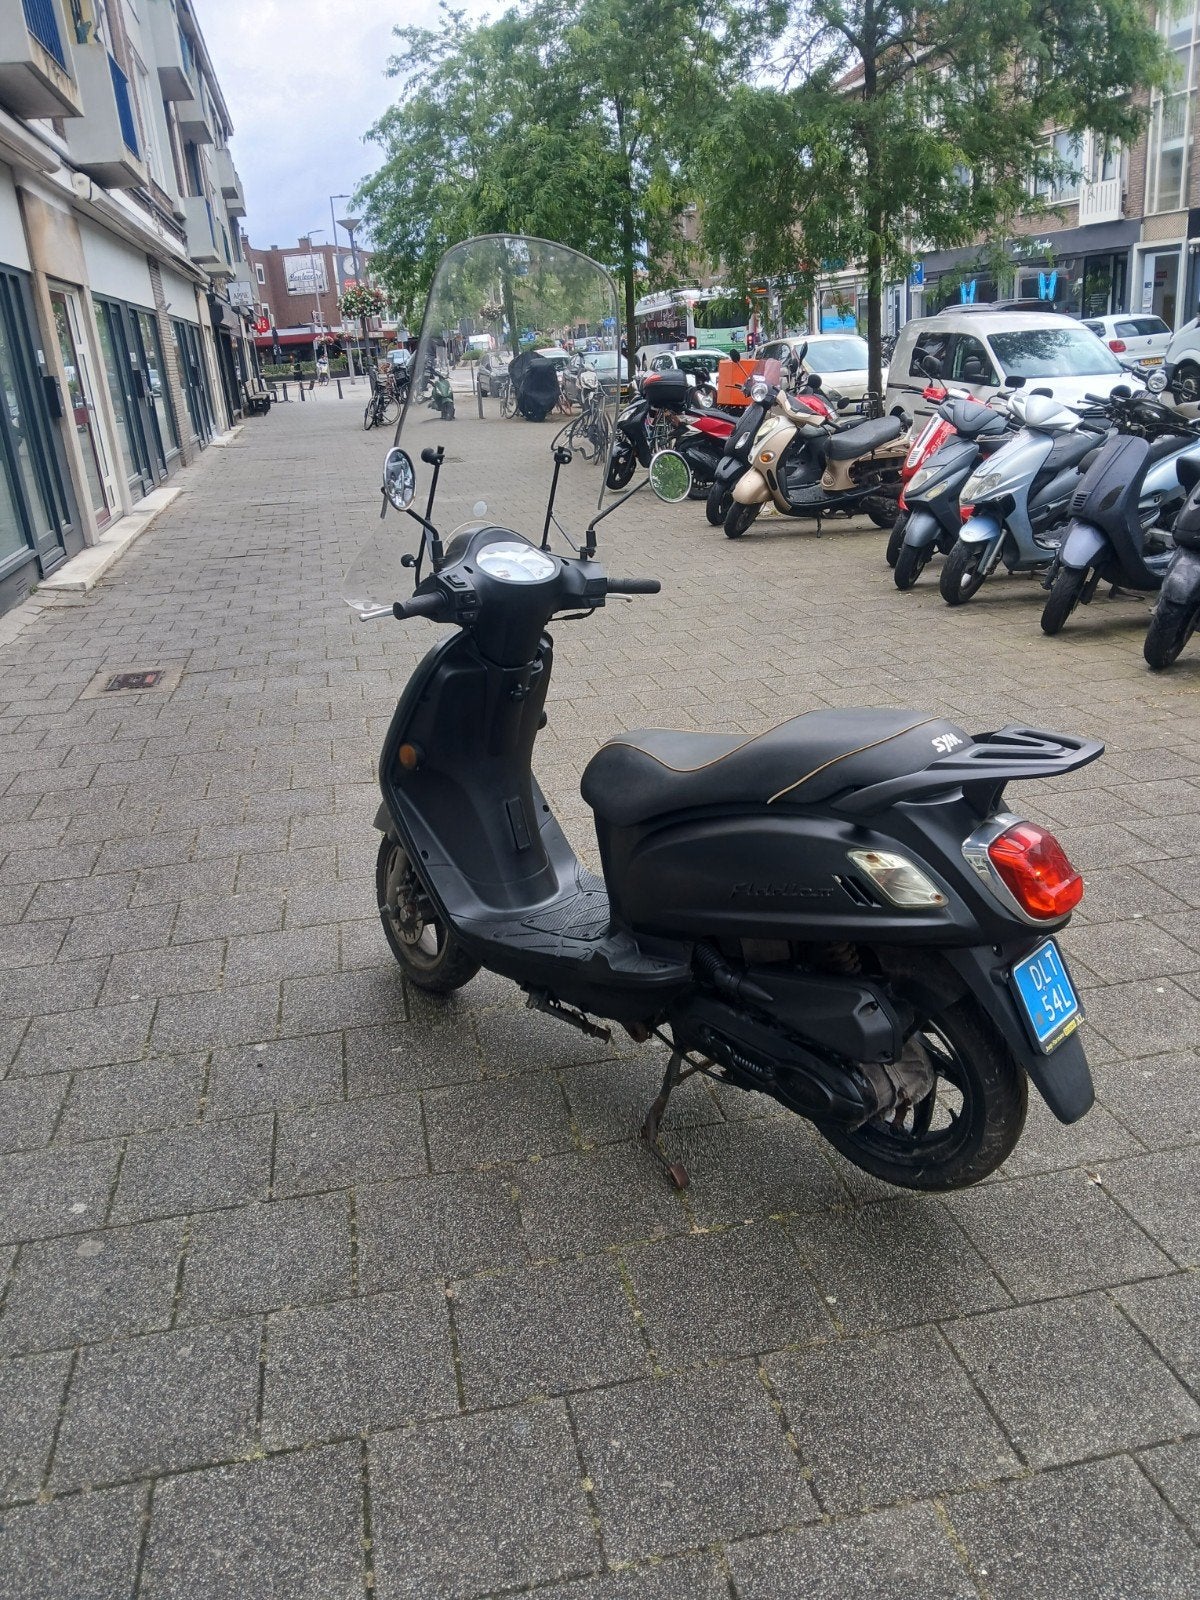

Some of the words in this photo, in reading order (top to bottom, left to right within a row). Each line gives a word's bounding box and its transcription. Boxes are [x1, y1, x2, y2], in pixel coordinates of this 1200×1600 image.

[931, 732, 963, 753] SYM
[1029, 950, 1058, 991] DLT
[1042, 984, 1071, 1022] 54L
